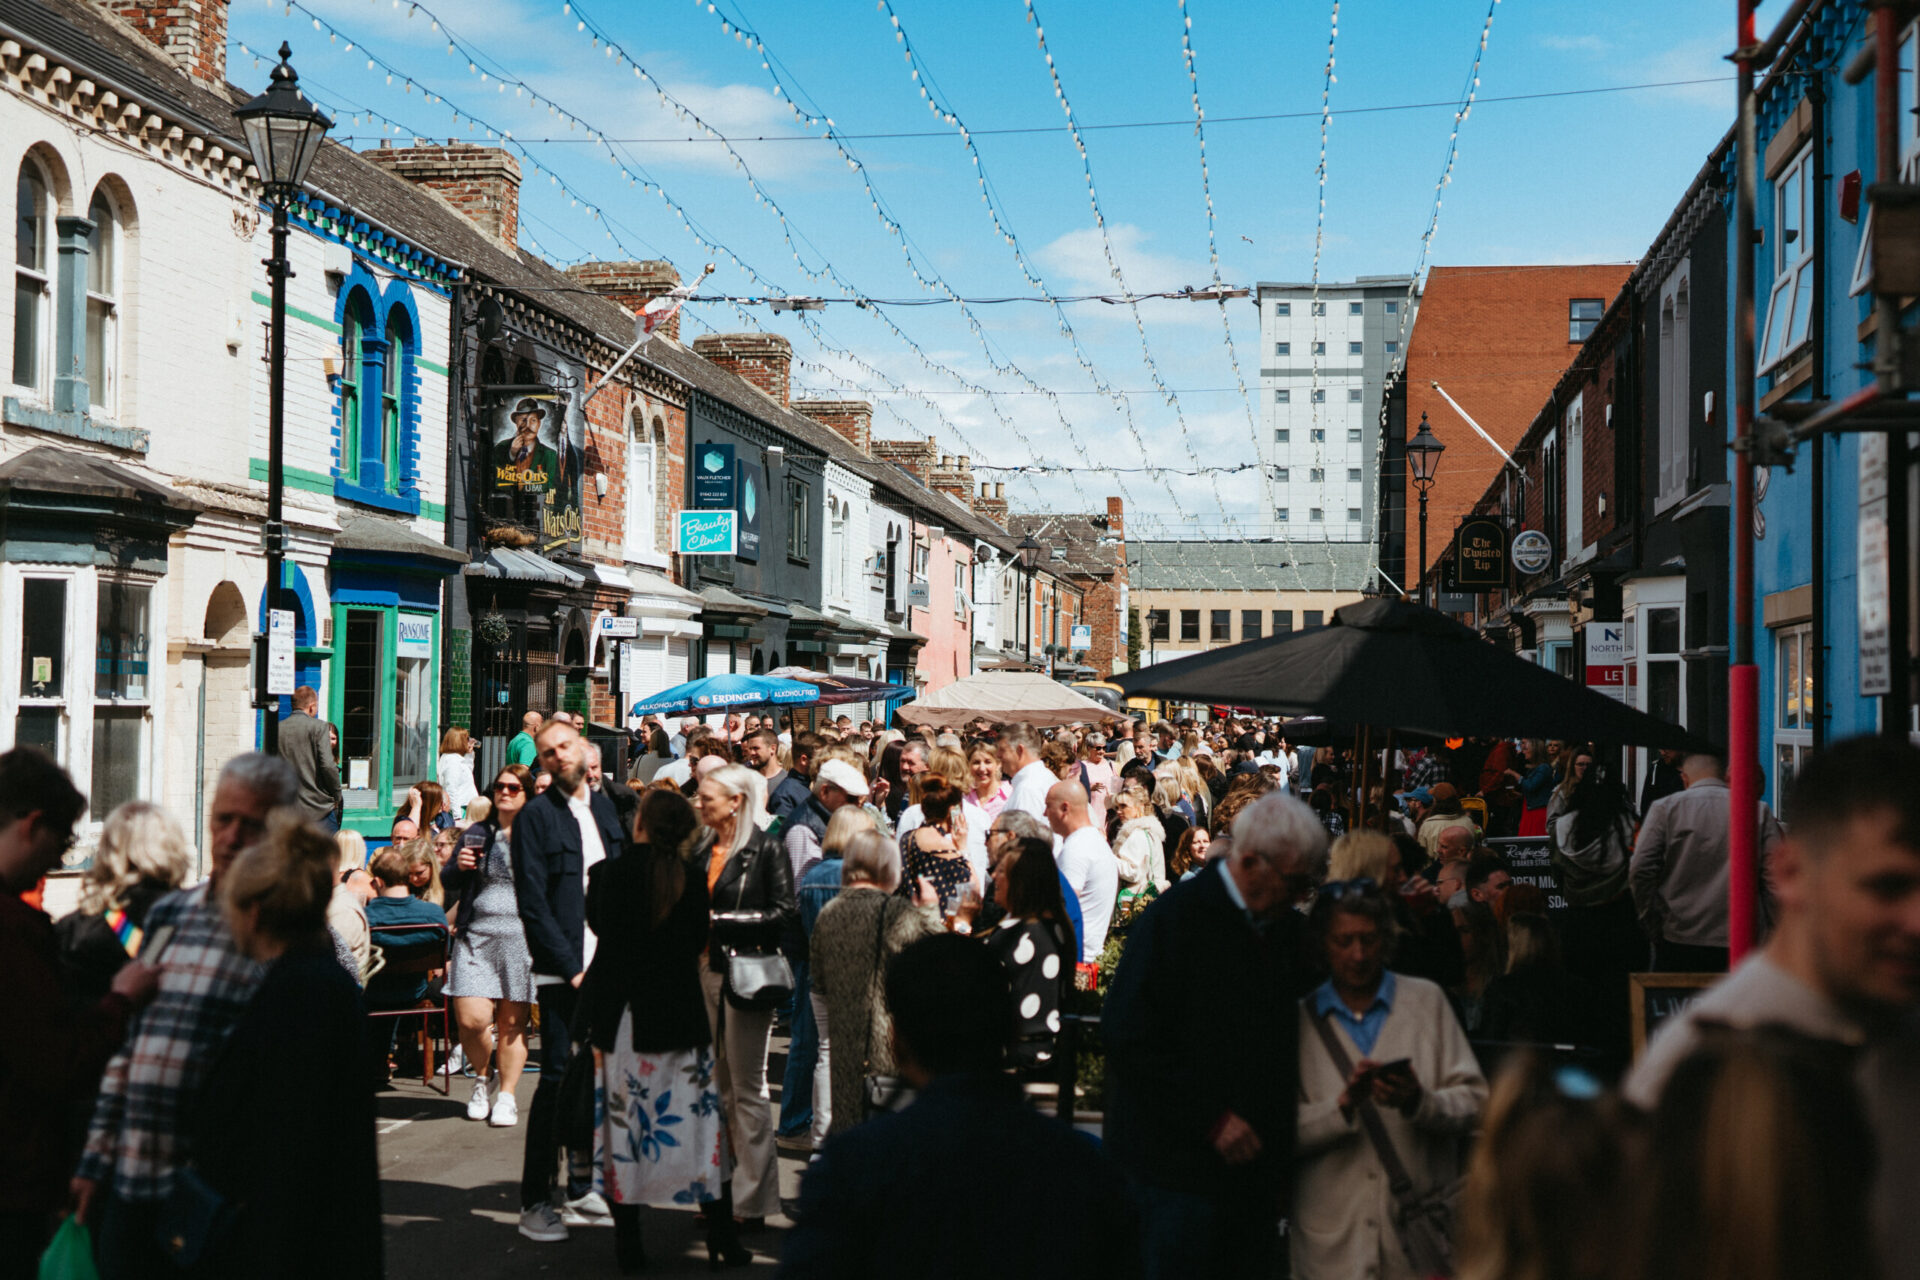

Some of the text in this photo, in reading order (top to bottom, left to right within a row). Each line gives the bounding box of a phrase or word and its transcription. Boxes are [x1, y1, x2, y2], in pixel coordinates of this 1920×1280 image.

[681, 514, 732, 536] Beauty
[687, 534, 725, 550] Clinic
[1472, 537, 1491, 549] The
[1463, 547, 1501, 559] Twisted
[1474, 559, 1491, 571] Lip
[712, 691, 761, 704] ERDINGER
